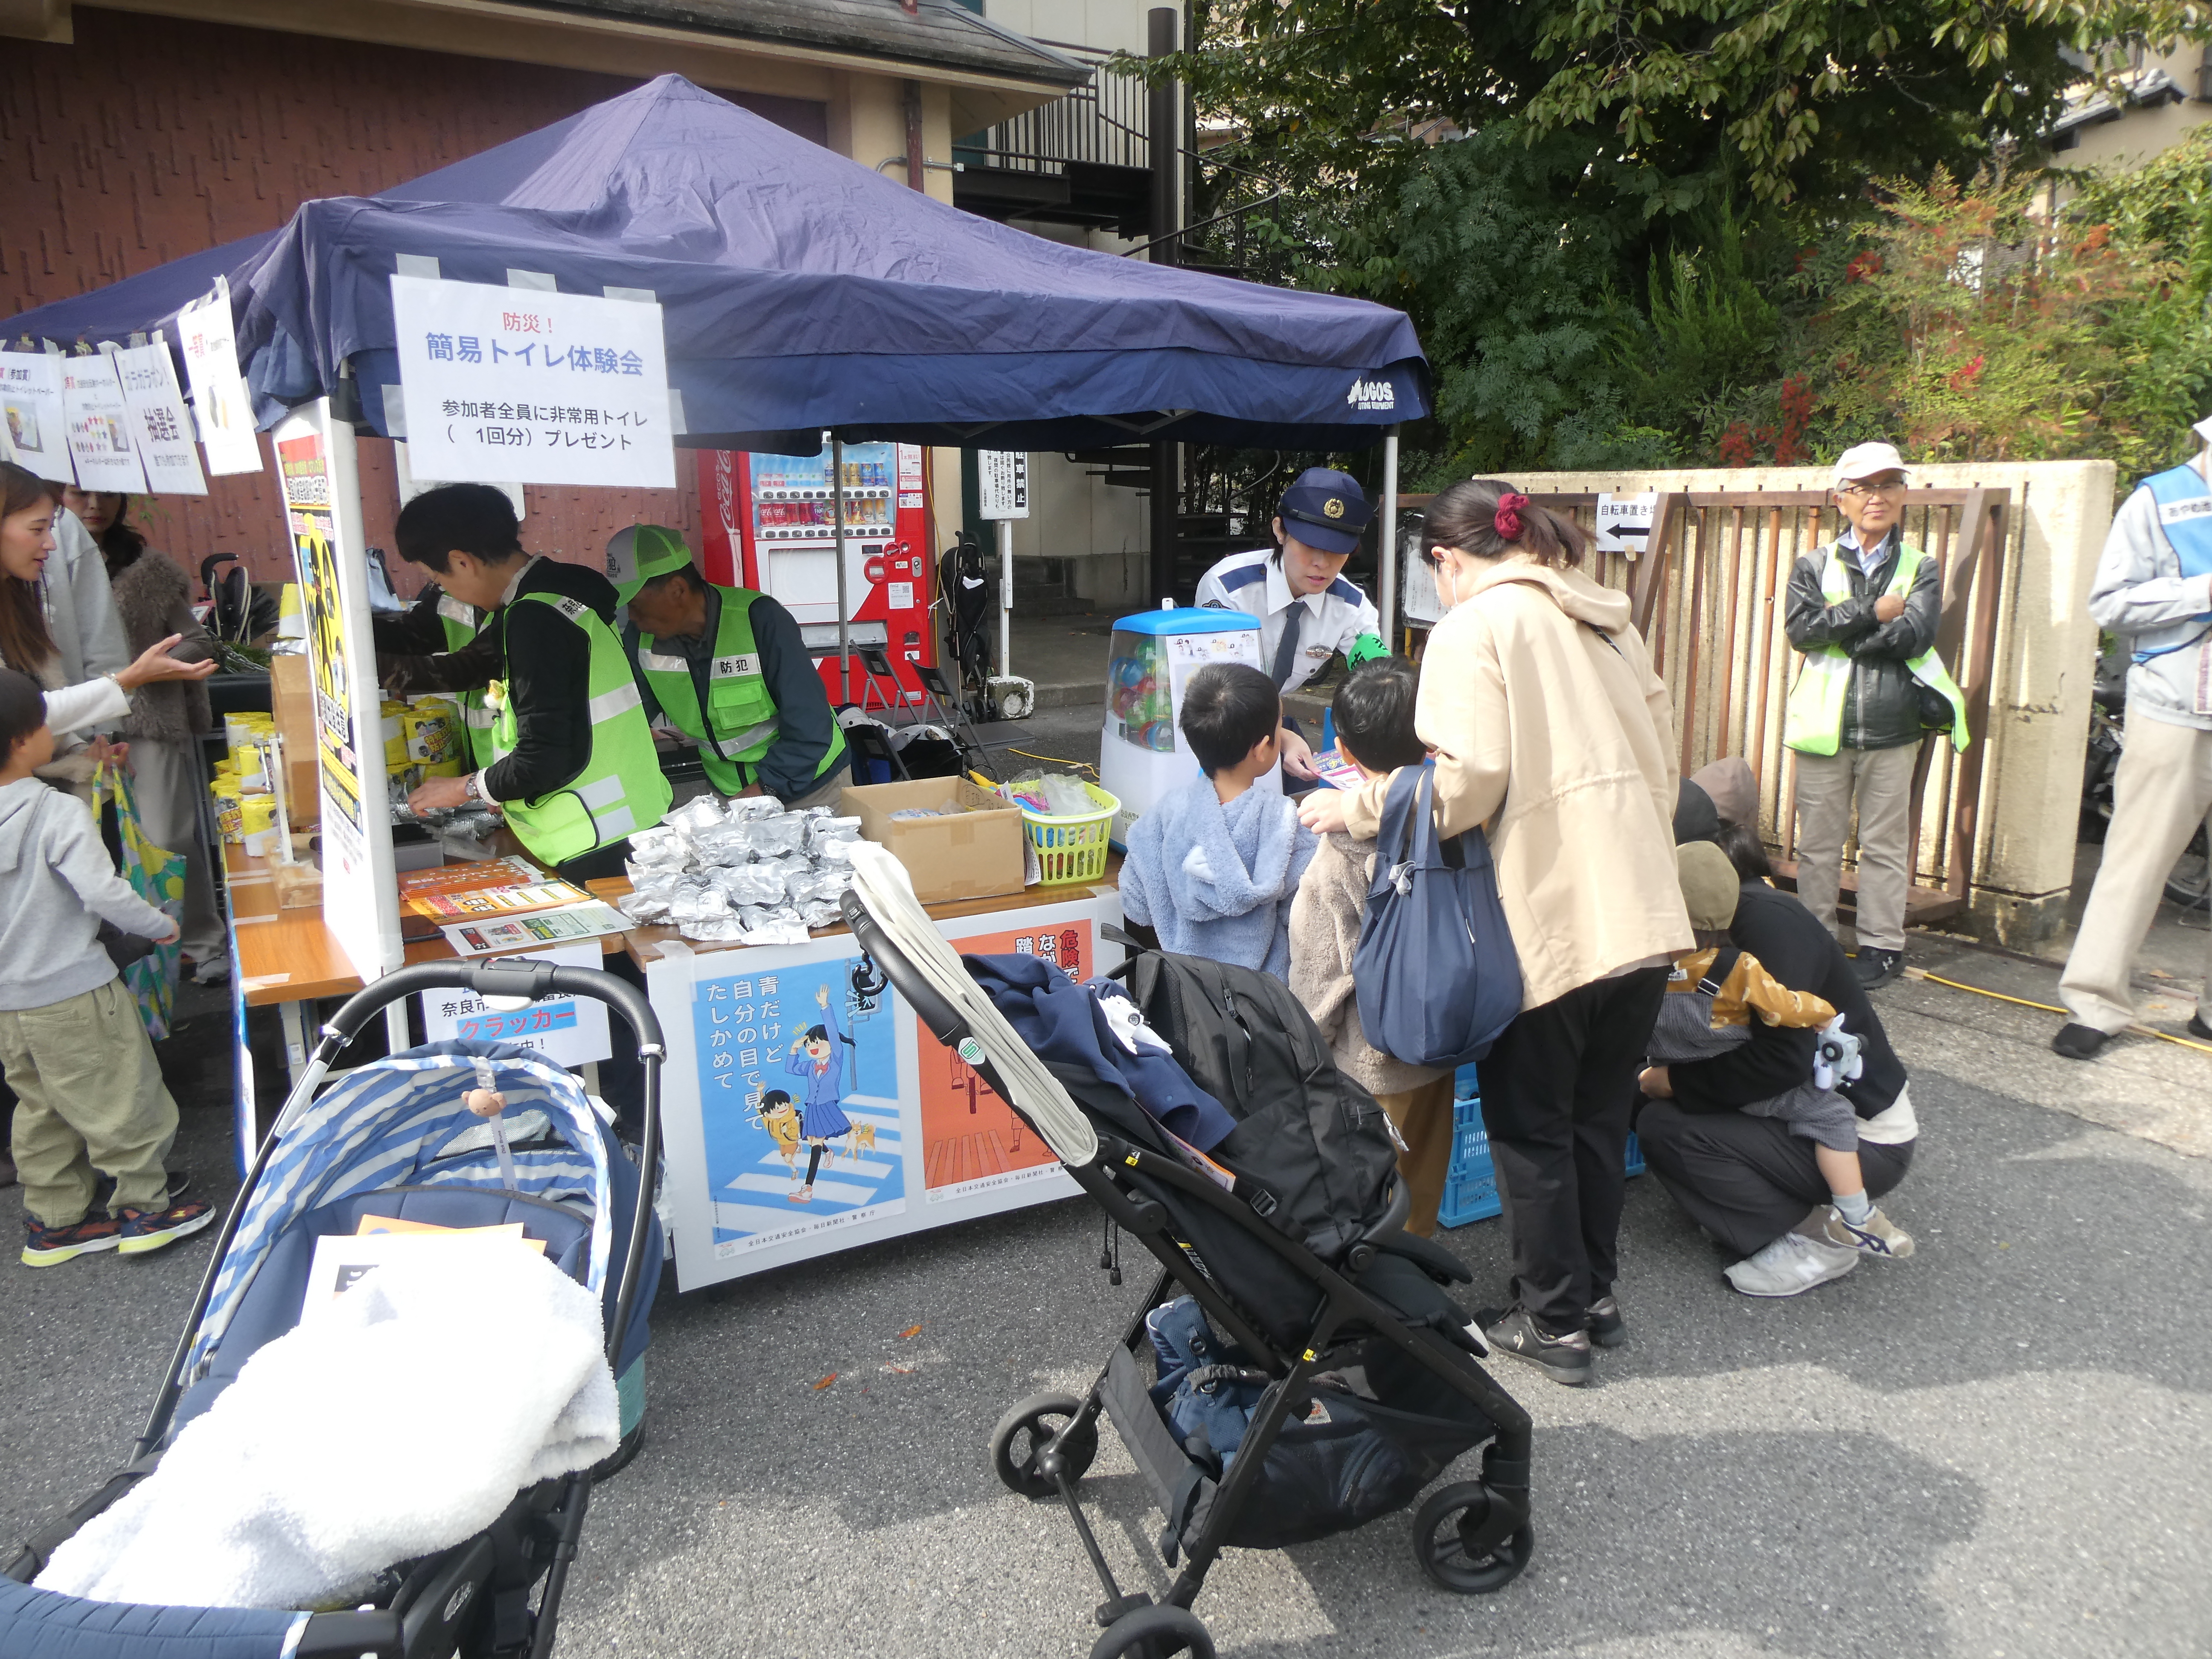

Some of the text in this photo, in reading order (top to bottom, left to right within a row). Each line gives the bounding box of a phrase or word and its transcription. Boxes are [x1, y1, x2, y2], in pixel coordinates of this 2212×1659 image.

[503, 311, 553, 334] 防災！
[425, 332, 643, 376] 簡易トイレ体験会
[143, 406, 181, 443] 抽選会
[442, 399, 648, 427] 参加者全員に非常用トイレ
[1015, 451, 1025, 504] 駐車禁止
[720, 659, 749, 674] 防犯
[1016, 936, 1034, 954] 踏
[460, 1009, 575, 1040] クラッカー
[706, 983, 734, 1090] たしかめて
[758, 975, 784, 1065] 青だけど
[733, 979, 765, 1132] 自分の目で見て
